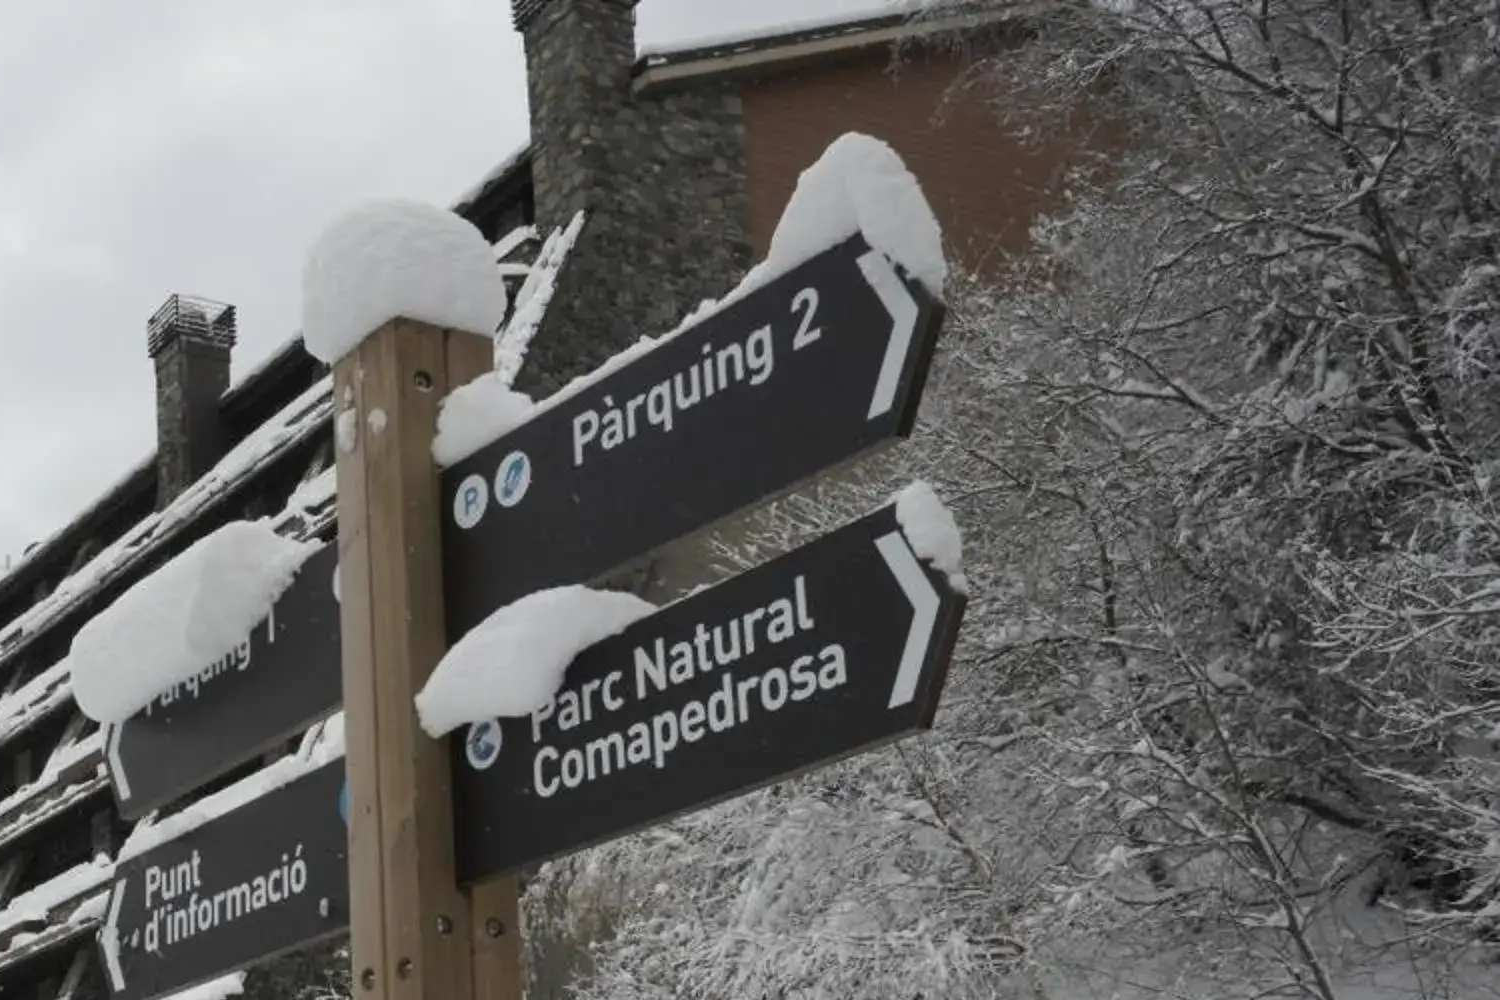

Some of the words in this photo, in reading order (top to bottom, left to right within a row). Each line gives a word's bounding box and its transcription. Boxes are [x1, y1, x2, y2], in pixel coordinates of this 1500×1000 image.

[573, 323, 774, 466] Pàrquing
[791, 287, 822, 351] 2
[531, 670, 624, 744] Parc
[633, 575, 815, 700] Natural
[533, 643, 848, 799] Comapedrosa
[145, 849, 201, 910] Punt
